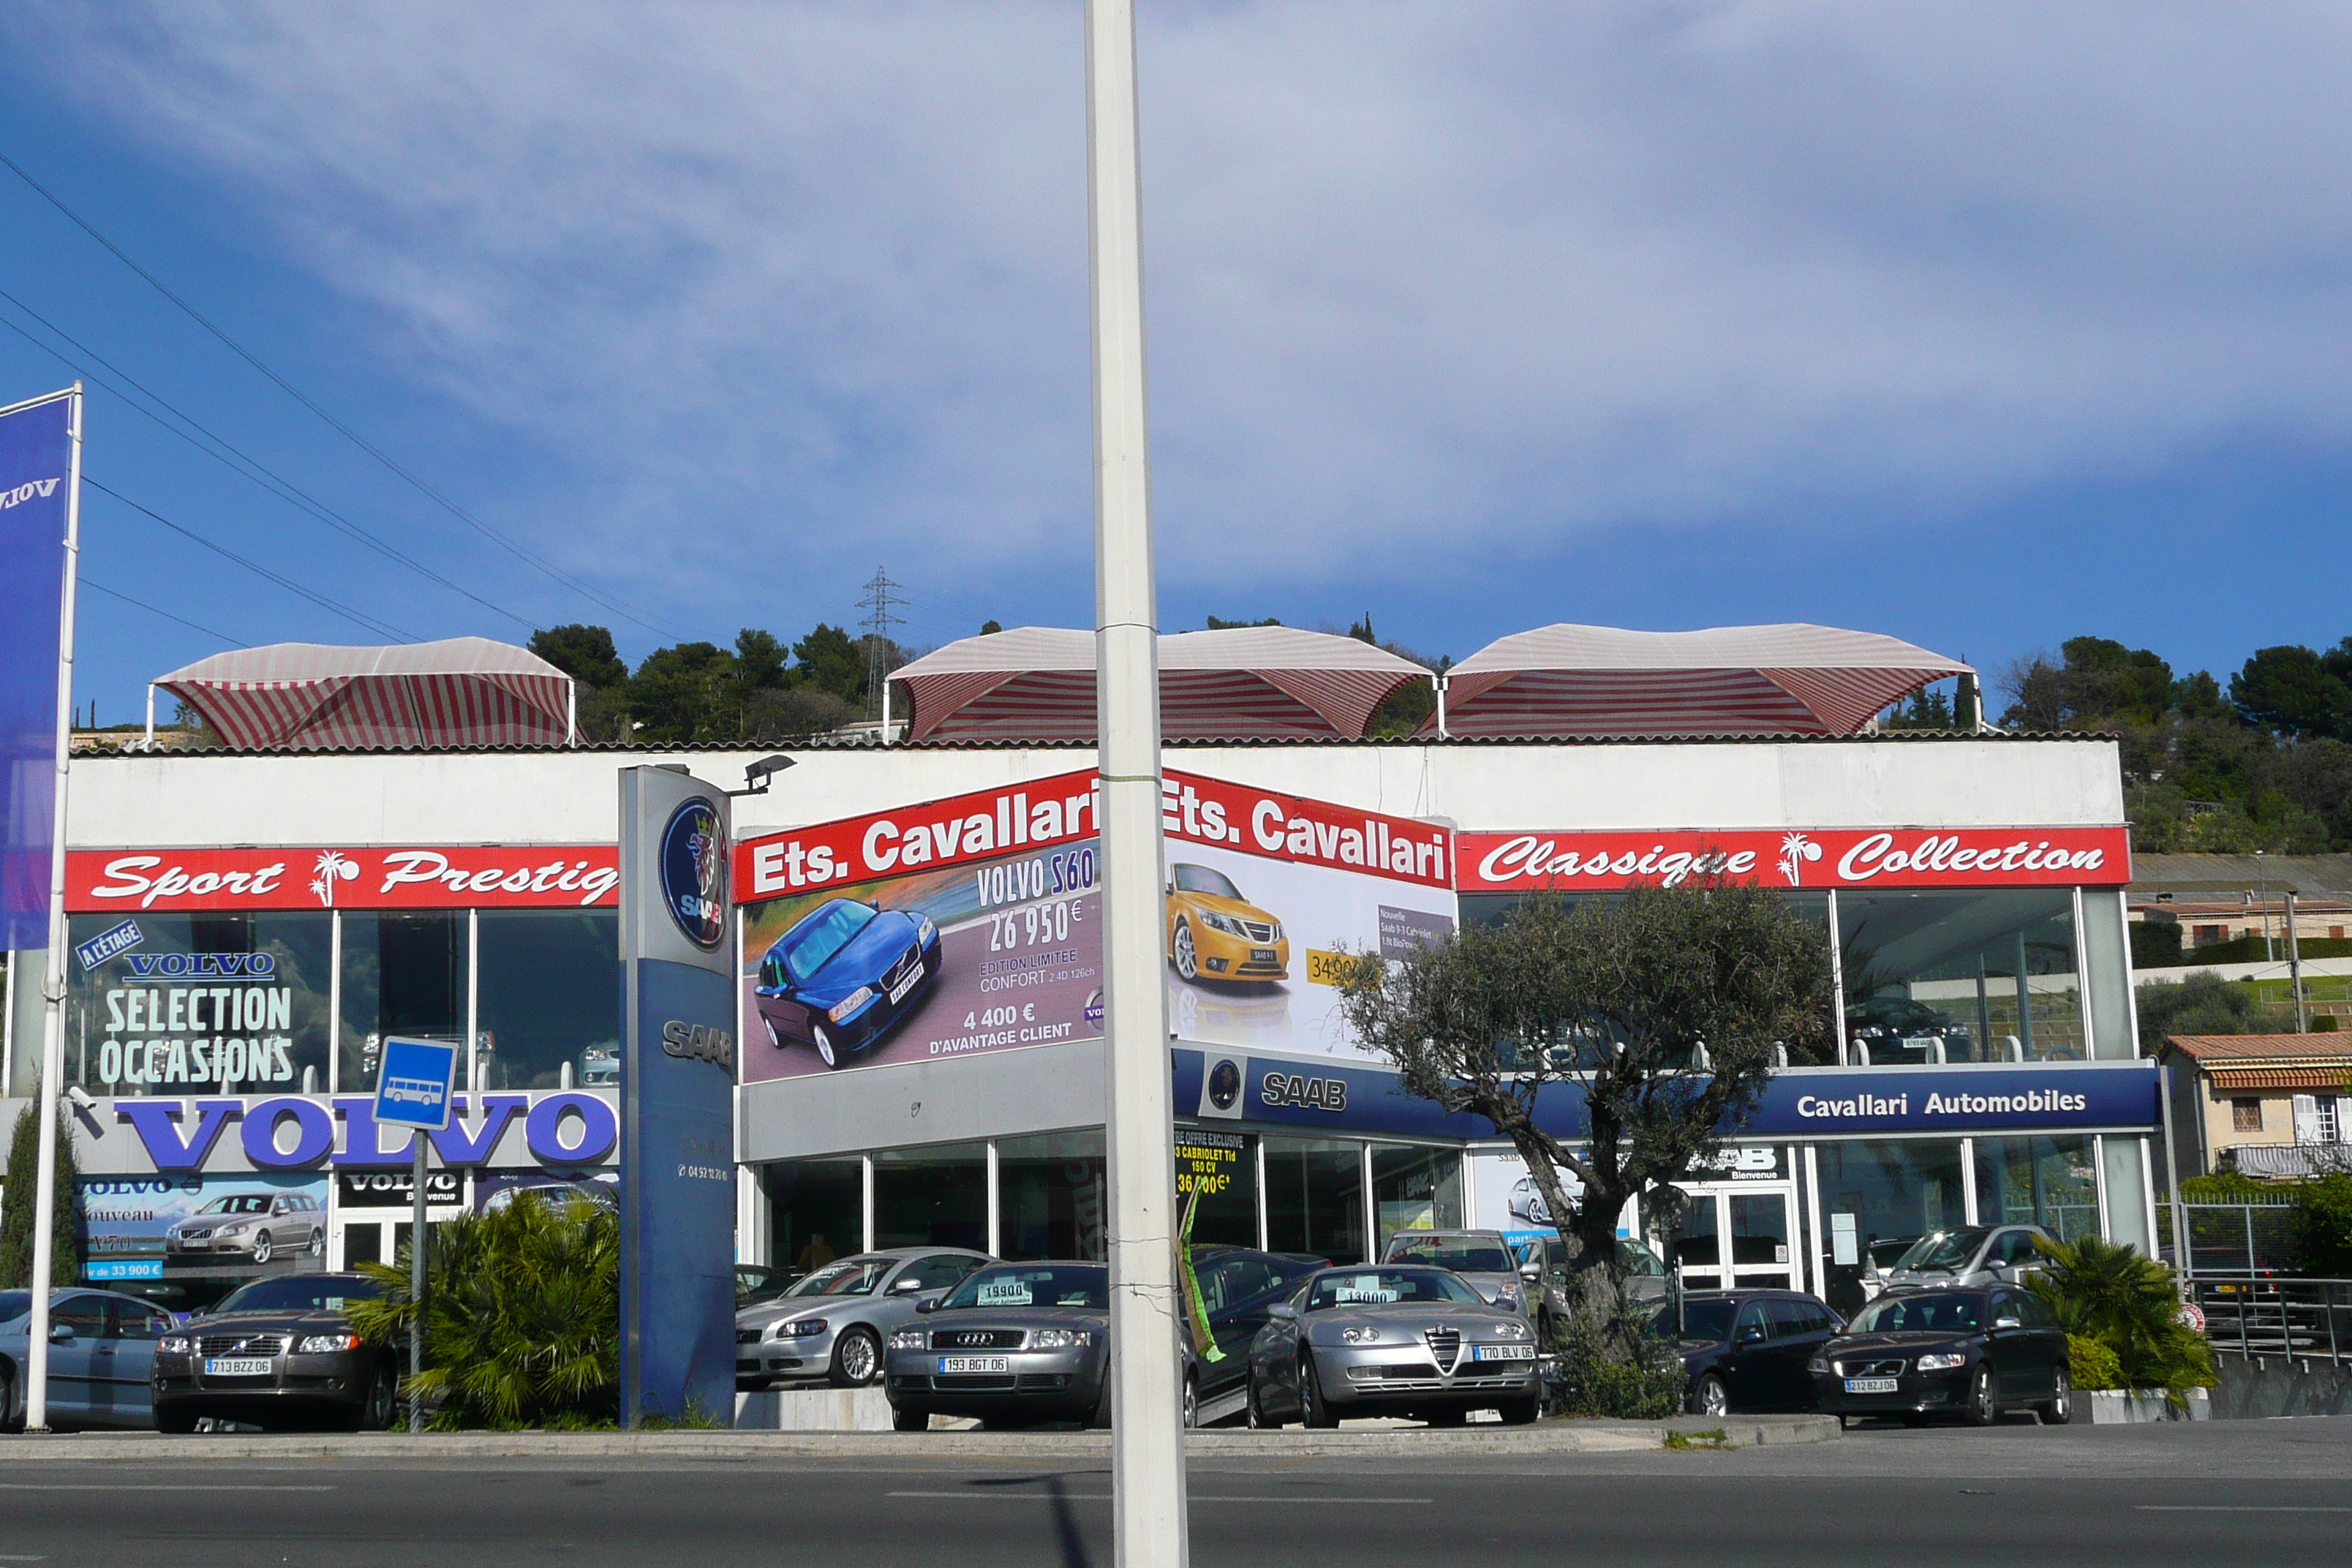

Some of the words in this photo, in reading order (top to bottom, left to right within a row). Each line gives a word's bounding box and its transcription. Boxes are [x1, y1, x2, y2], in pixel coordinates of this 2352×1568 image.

[754, 842, 848, 894] Ets.
[862, 778, 1099, 871] Cavallari
[1162, 777, 1240, 843] Ets.
[1252, 799, 1444, 880] Cavallari
[1478, 836, 1757, 889] Classique
[1836, 833, 2104, 882] Collection
[91, 856, 285, 908] Sport
[977, 859, 1044, 907] VOLVO
[1051, 848, 1095, 895] S60
[681, 894, 722, 925] SAAB
[1380, 909, 1406, 921] Nouvelle
[990, 910, 1017, 951] 26
[1381, 922, 1395, 933] Saab
[1396, 924, 1406, 935] 9-3
[124, 952, 275, 976] VOLVO
[980, 957, 1026, 976] EDITION
[1030, 949, 1077, 968] LIMITEE
[892, 987, 902, 1001] S60
[902, 965, 923, 992] CONFORT
[980, 970, 1047, 992] CONFORT
[1049, 971, 1068, 983] 2.4D
[1071, 968, 1095, 979] 126ch
[105, 987, 291, 1033] SELECTION
[981, 1006, 1017, 1028] 400
[663, 1020, 732, 1066] SAAB
[930, 1030, 1017, 1055] D'AVANTAGE
[1019, 1022, 1072, 1041] CLIENT
[99, 1039, 293, 1084] OCCASIONS
[1262, 1071, 1347, 1112] SAAB
[1797, 1093, 1908, 1117] Cavallari
[1923, 1090, 2087, 1115] Automobiles
[114, 1093, 618, 1169] VOLVO
[1186, 1131, 1207, 1145] OFFRE
[1208, 1133, 1244, 1149] EXCLUSIVE
[1182, 1146, 1224, 1161] CABRIOLET
[1499, 1153, 1520, 1162] Saab
[688, 1166, 698, 1177] 04
[1191, 1160, 1205, 1172] 150
[1206, 1161, 1216, 1173] CV
[1731, 1172, 1778, 1180] Bienvenue
[73, 1178, 173, 1195] VOLVO
[94, 1234, 131, 1251] V70
[112, 1265, 126, 1275] 33
[129, 1265, 149, 1275] 900
[986, 1285, 1022, 1297] 19900
[1348, 1291, 1387, 1303] 13000
[948, 1359, 965, 1371] 193
[969, 1359, 987, 1371] BGT
[992, 1359, 1004, 1370] 06
[1481, 1347, 1499, 1359] 770
[1501, 1347, 1518, 1358] BLV
[1522, 1347, 1533, 1358] 06
[213, 1362, 232, 1372] 713
[234, 1362, 254, 1372] BZZ
[256, 1361, 268, 1372] 06
[1851, 1382, 1866, 1390] 212
[1867, 1381, 1883, 1390] BZJ
[1884, 1380, 1896, 1390] 06
